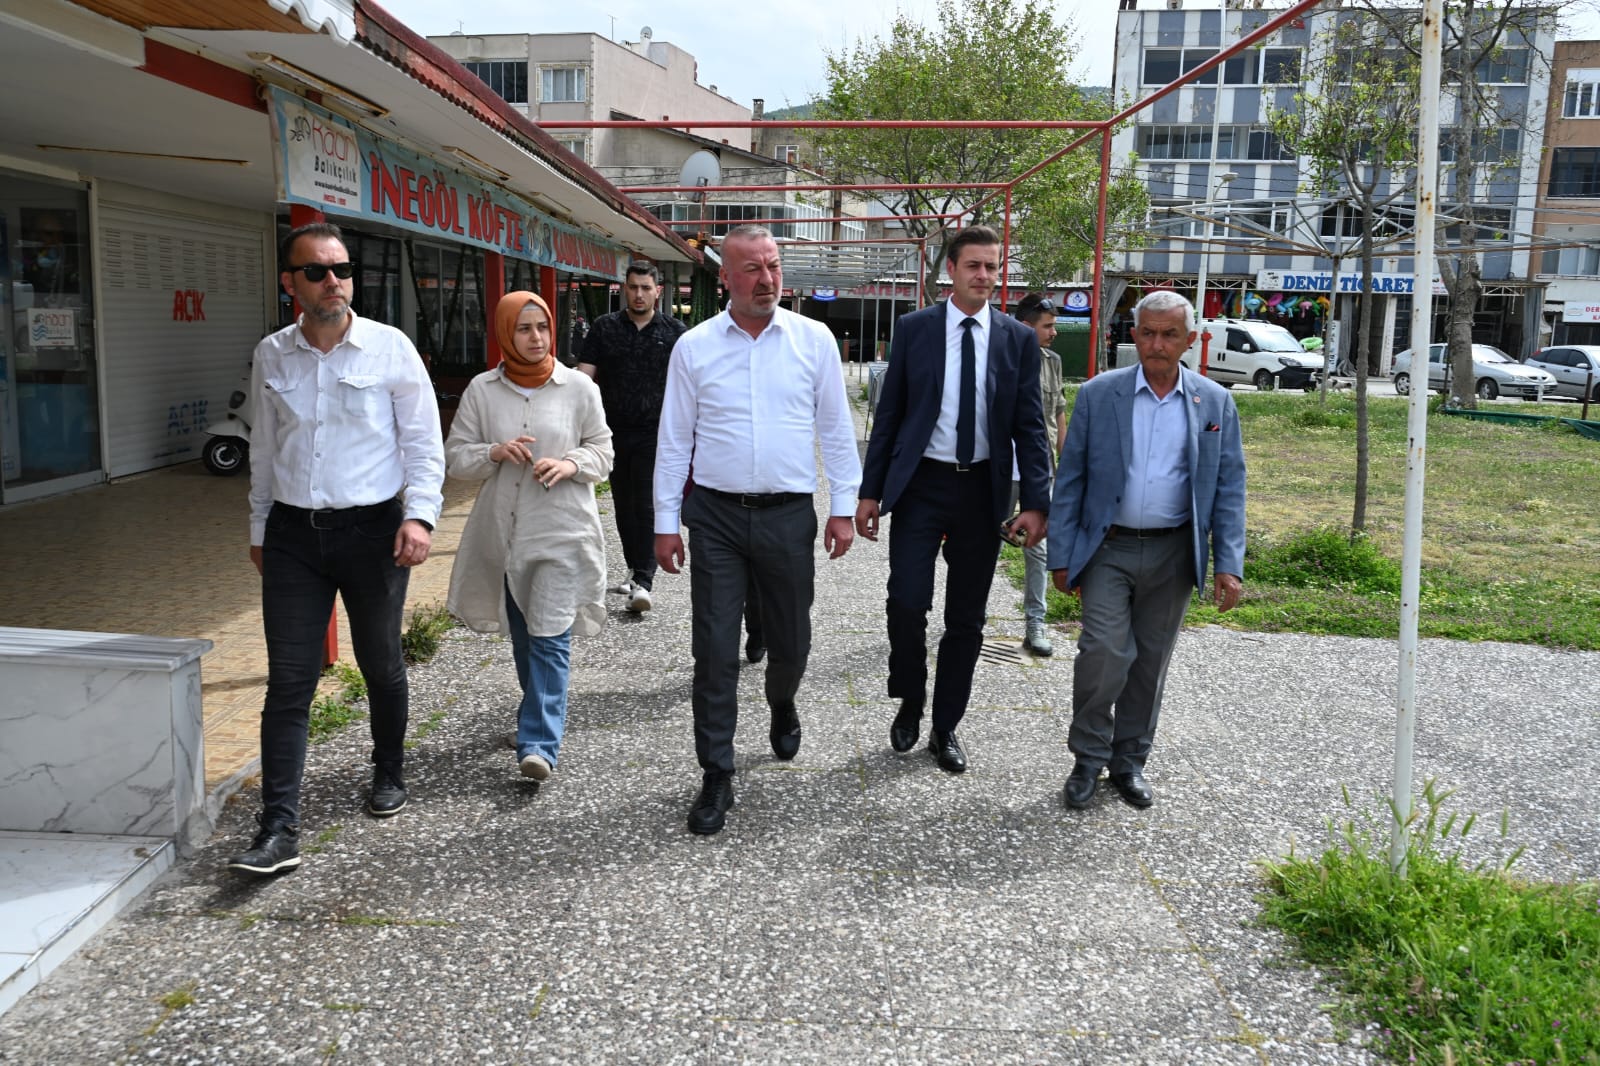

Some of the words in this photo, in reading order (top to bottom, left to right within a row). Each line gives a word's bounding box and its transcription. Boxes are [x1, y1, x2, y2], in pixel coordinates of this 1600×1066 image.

[369, 151, 465, 237] İNEGÖL
[467, 188, 524, 252] KÖFTE
[1282, 272, 1332, 291] DENİZ
[172, 289, 206, 322] AÇIK
